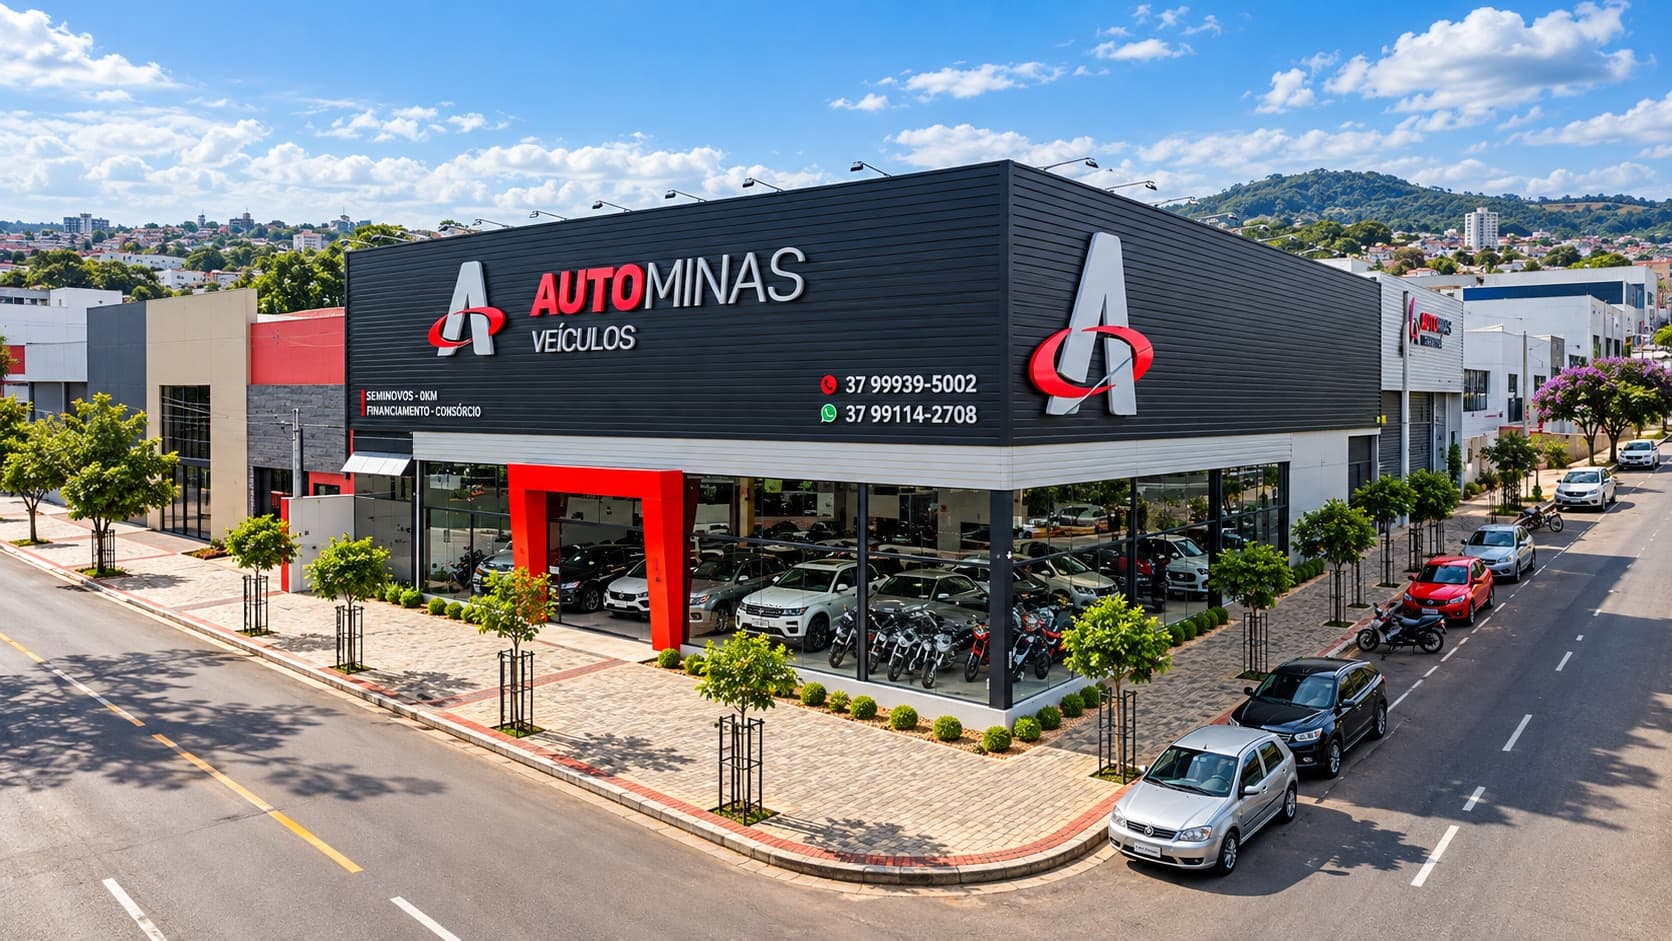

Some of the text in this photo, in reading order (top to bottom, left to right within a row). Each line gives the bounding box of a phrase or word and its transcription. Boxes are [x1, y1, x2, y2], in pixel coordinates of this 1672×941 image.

[529, 246, 807, 318] AUTOMINAS
[531, 322, 638, 354] VEÍCULOS
[845, 374, 977, 394] 37 99939-5002
[366, 390, 414, 401] SEMINOVOS
[366, 405, 430, 417] FINANCIAMENTO
[435, 403, 482, 417] CONSÓRCIO
[845, 404, 977, 424] 37 99114-2708
